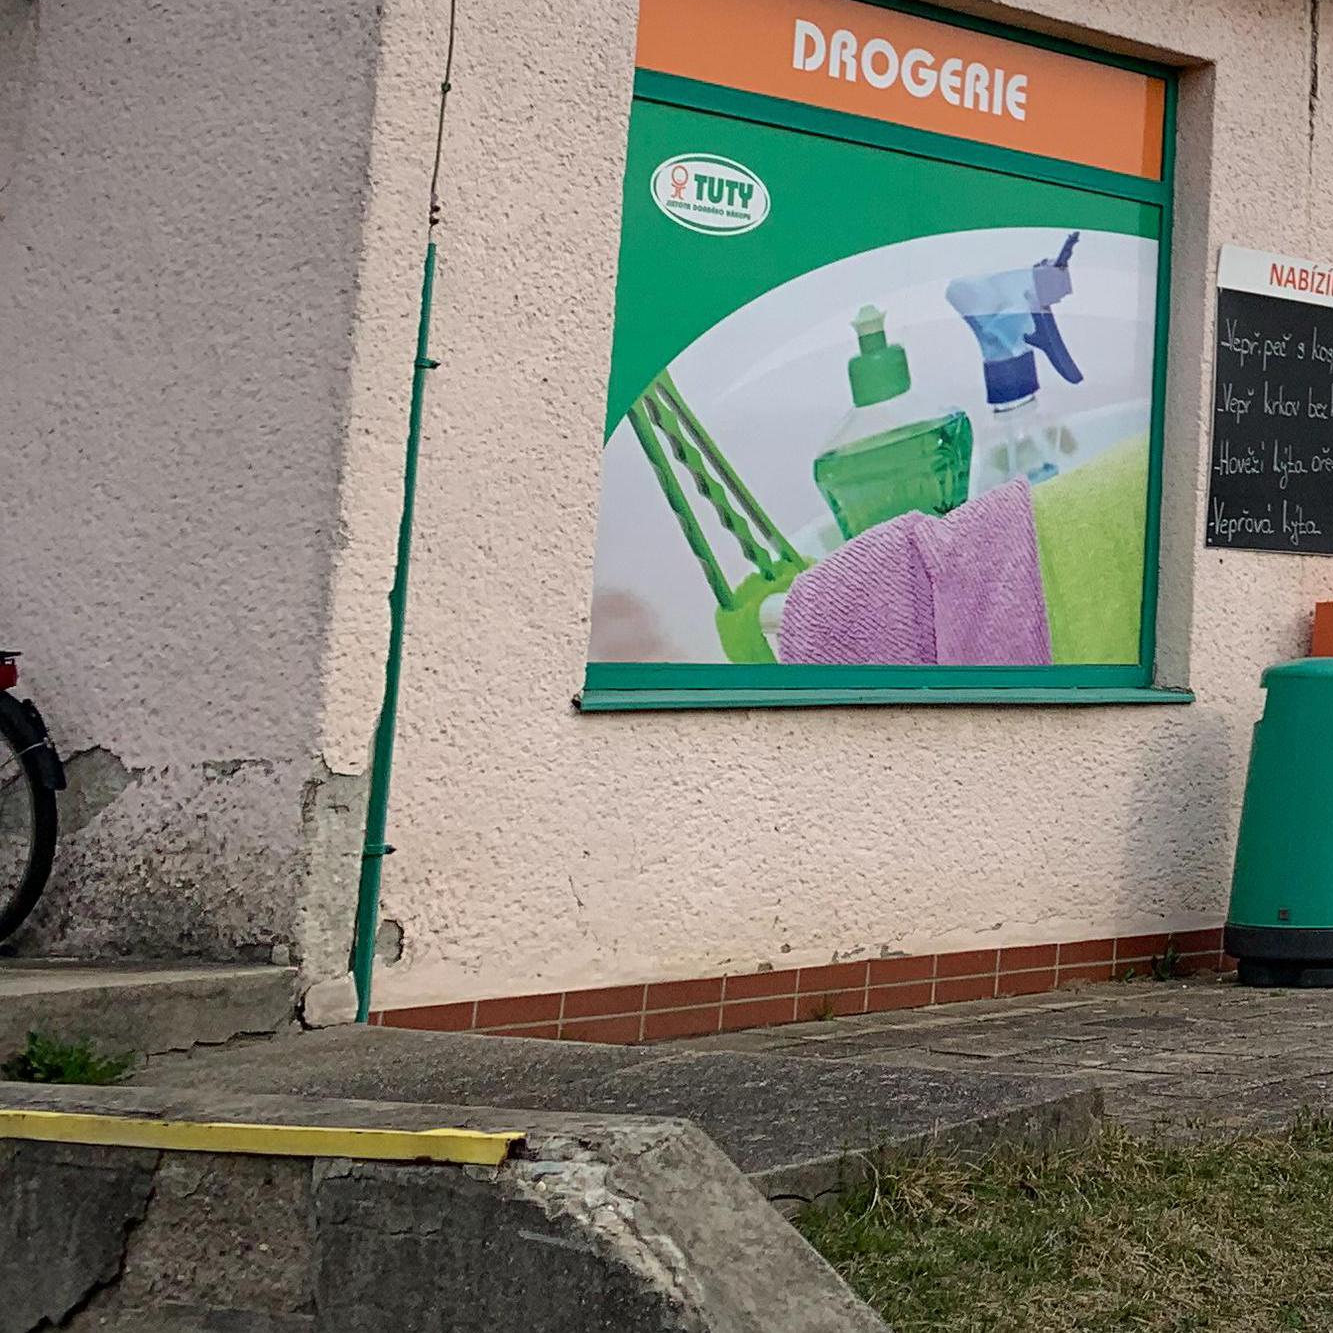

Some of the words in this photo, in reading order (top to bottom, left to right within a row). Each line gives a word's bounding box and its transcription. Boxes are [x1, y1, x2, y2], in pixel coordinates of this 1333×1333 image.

[792, 19, 1028, 121] DROGERIE
[694, 173, 754, 209] TUTY
[1297, 342, 1305, 359] s
